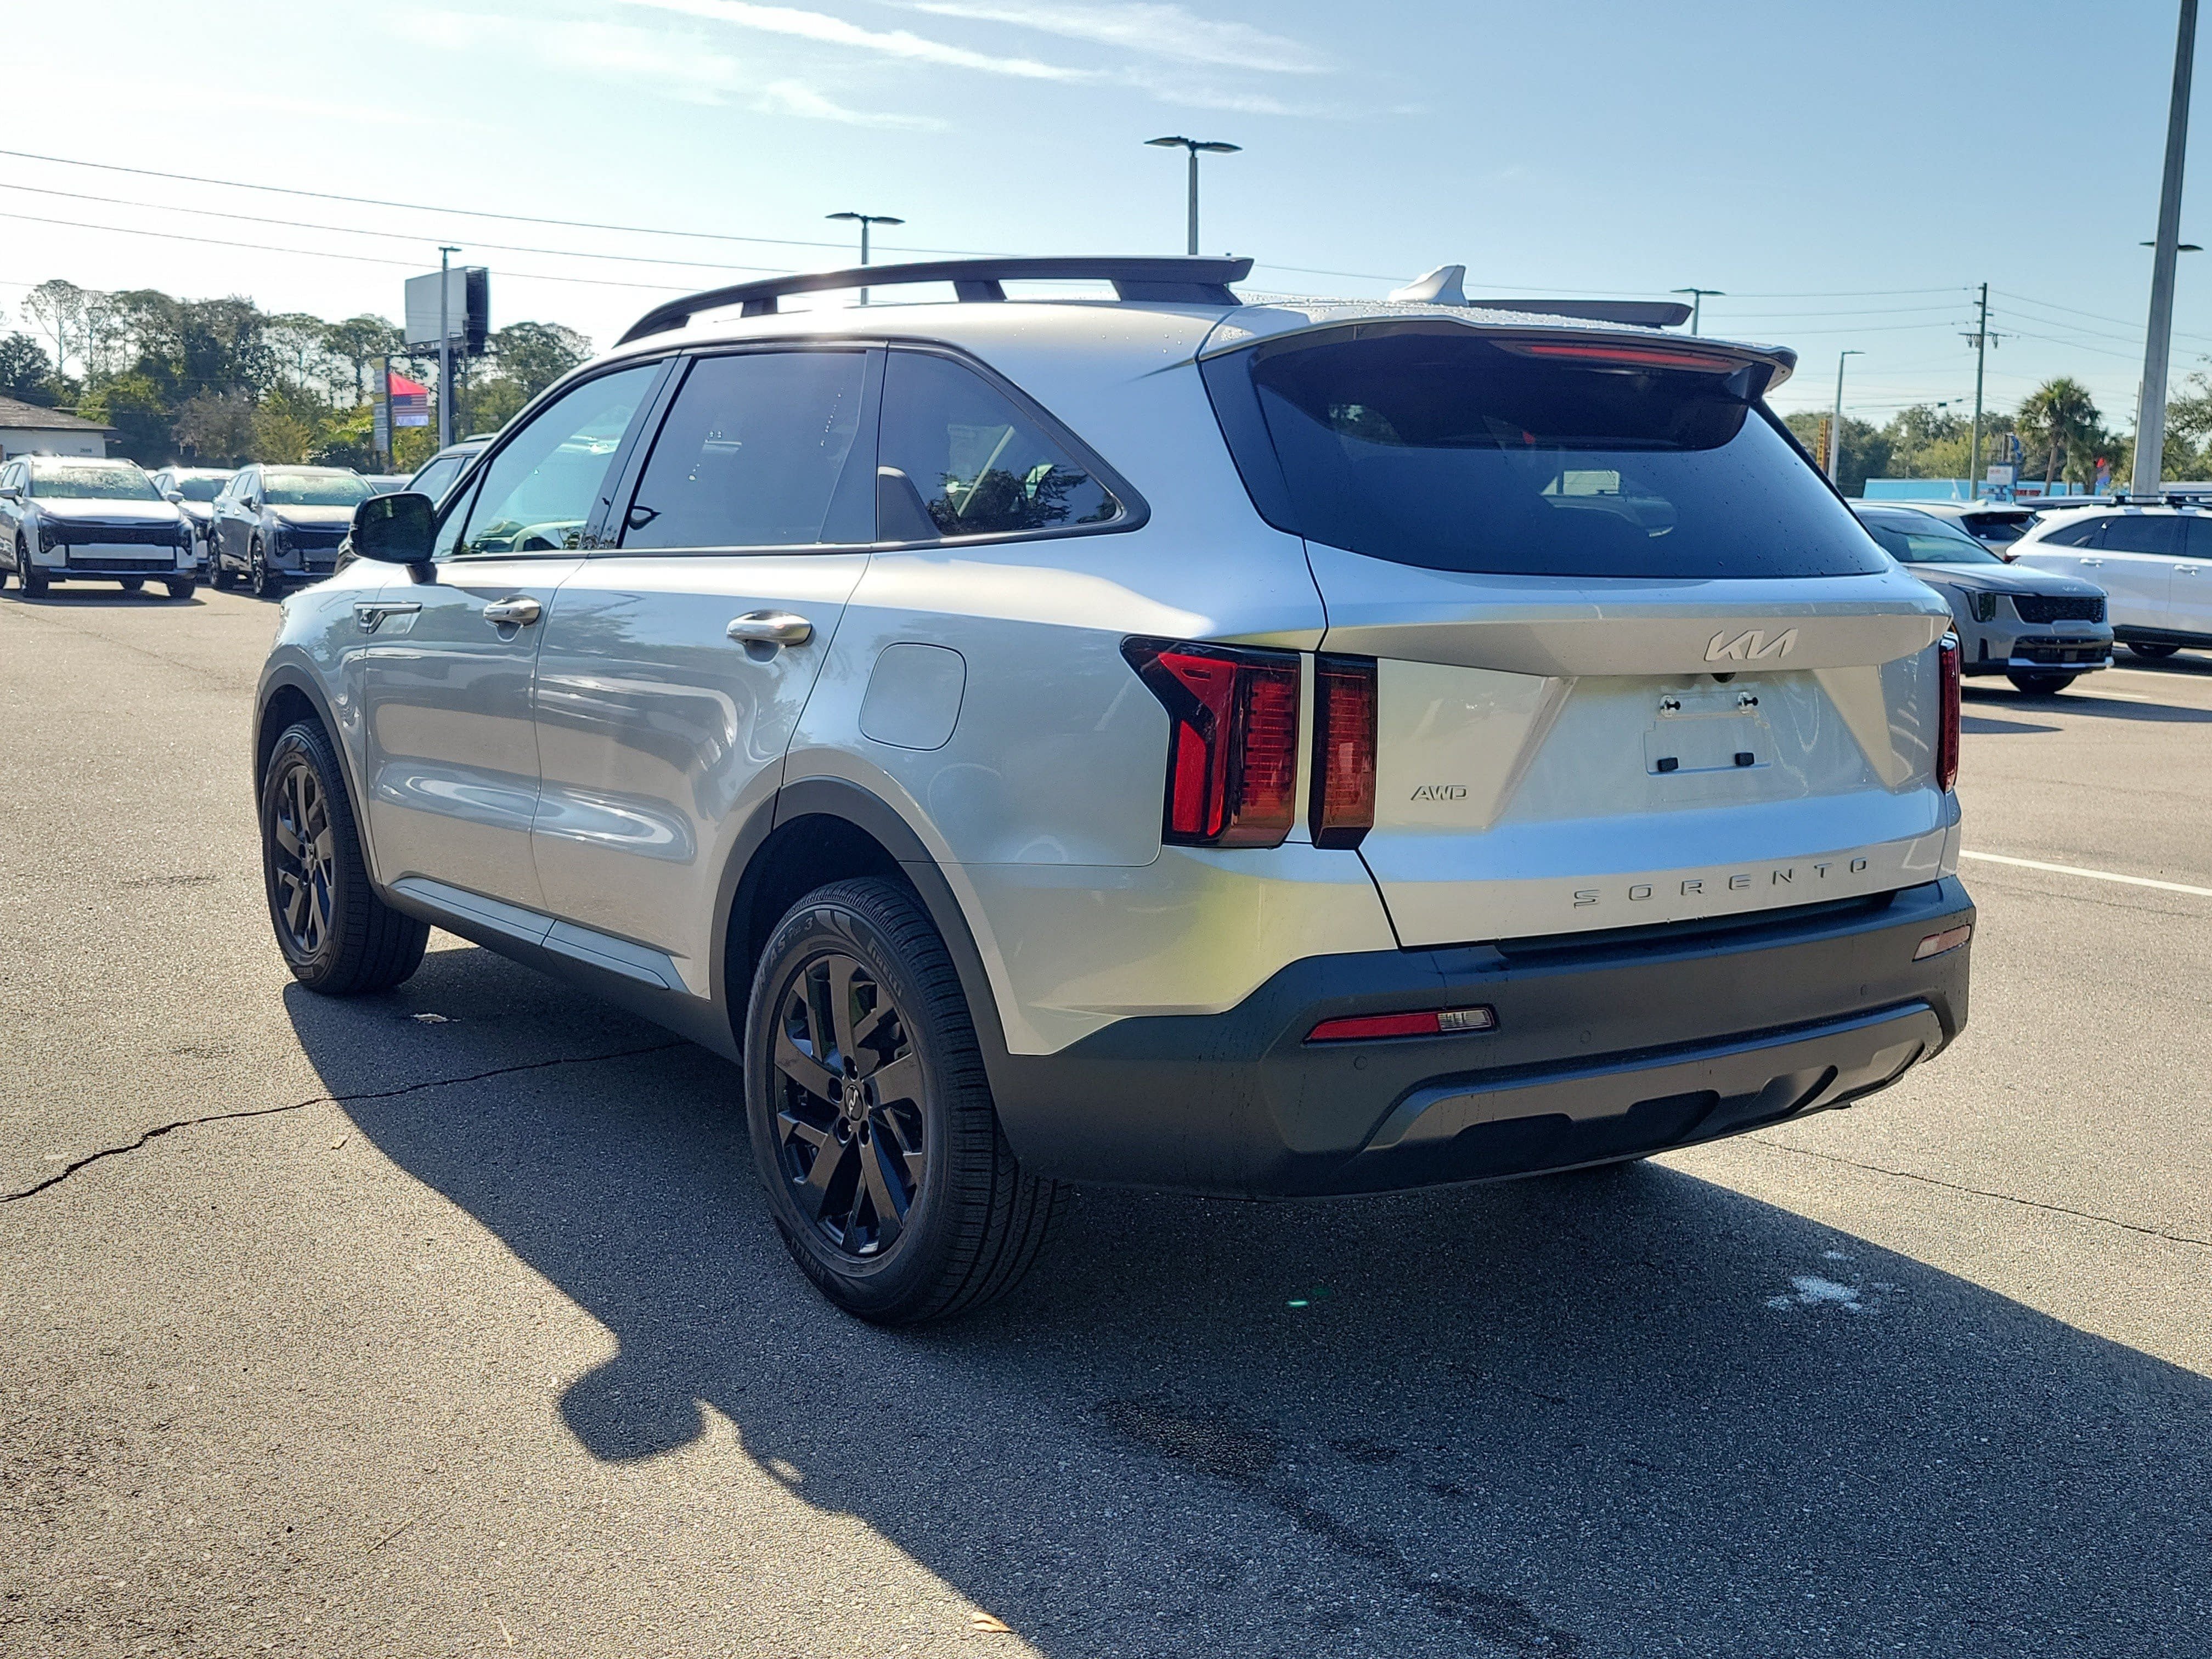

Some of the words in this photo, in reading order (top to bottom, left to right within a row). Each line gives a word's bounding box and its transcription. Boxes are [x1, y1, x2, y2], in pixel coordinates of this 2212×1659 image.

[1410, 785, 1467, 800] AWD
[1574, 857, 1868, 909] SORENTO
[867, 937, 902, 997] PIRELLI
